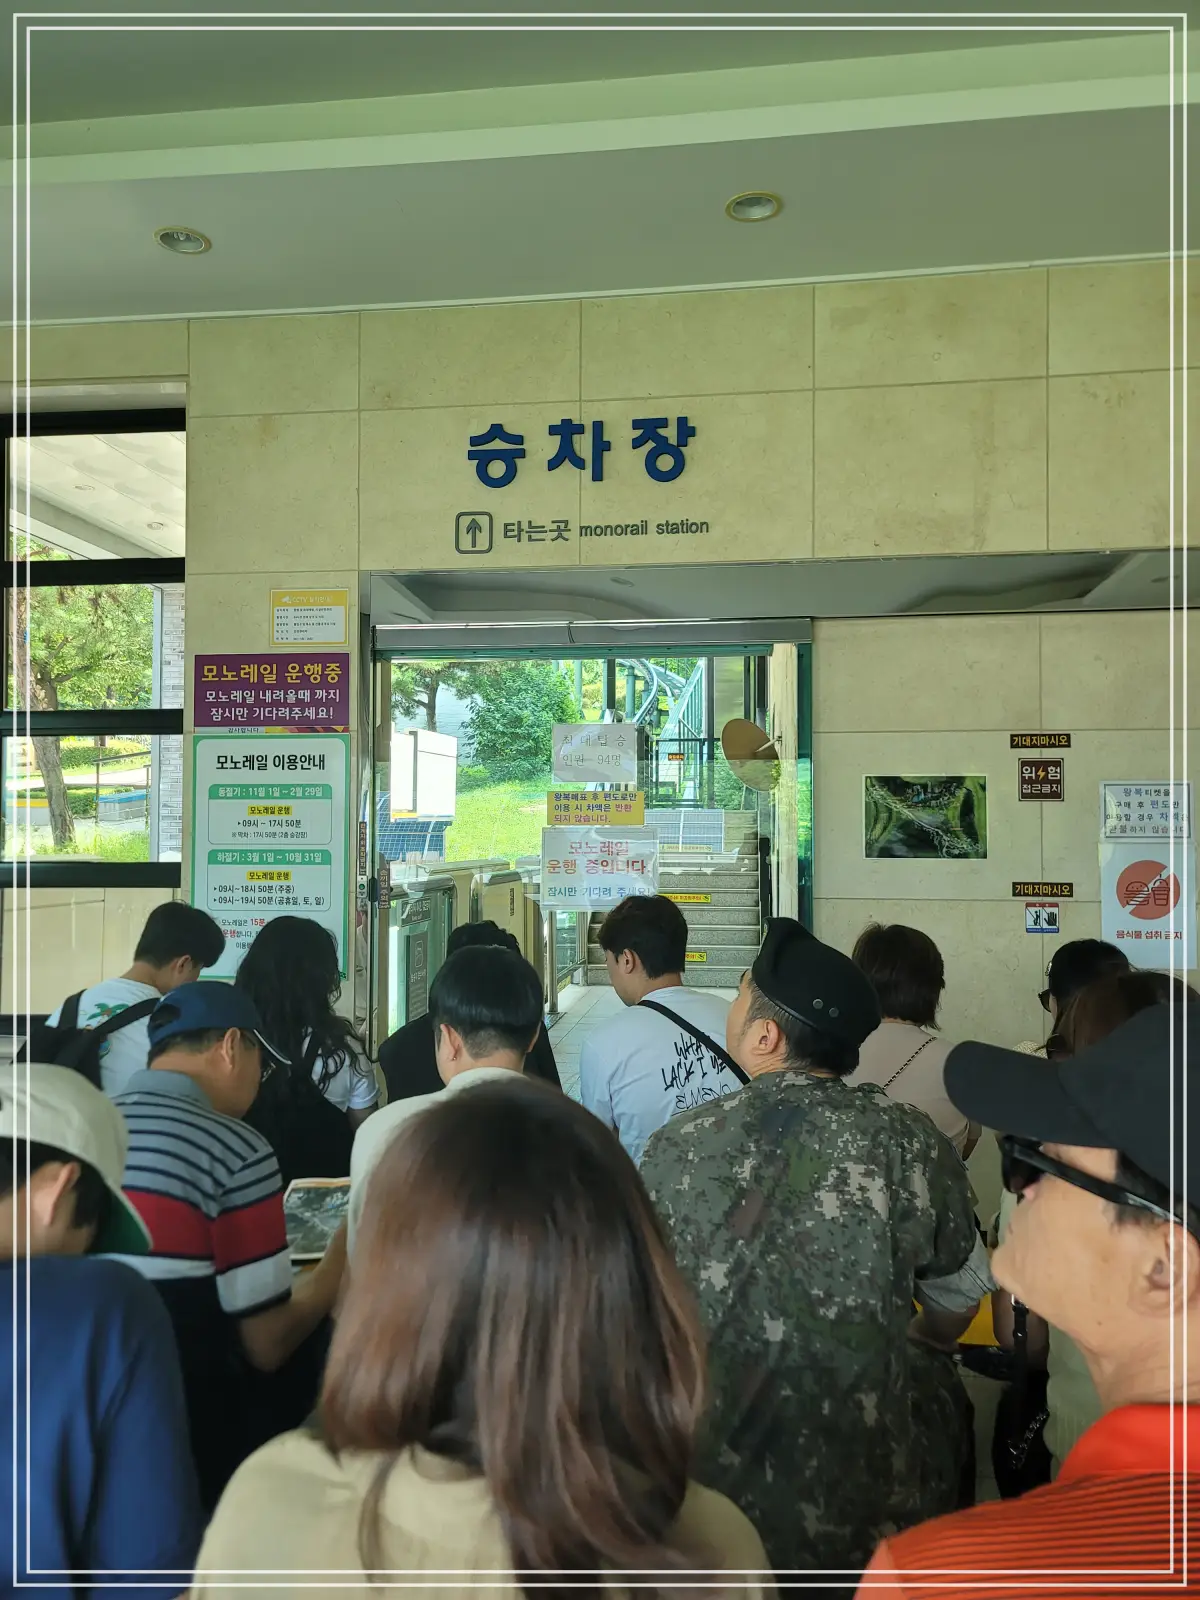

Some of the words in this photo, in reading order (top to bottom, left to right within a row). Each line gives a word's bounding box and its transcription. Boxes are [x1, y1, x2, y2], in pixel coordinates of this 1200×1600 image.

[467, 416, 697, 489] 승차장
[503, 519, 571, 543] 타는곳
[579, 520, 648, 538] monorail
[655, 519, 709, 535] station
[201, 663, 277, 684] 모노레일
[284, 662, 342, 684] 운행중
[205, 689, 255, 704] 모노레일
[259, 689, 311, 704] 내려올때
[314, 689, 340, 703] 까지
[210, 707, 248, 721] 잠시만
[252, 706, 334, 721] 기다려주세요!
[1012, 735, 1069, 747] 기대지마시오
[215, 754, 268, 771] 모노레일
[273, 754, 325, 771] 이용안내
[562, 753, 585, 767] 인원
[597, 753, 621, 767] 94명
[218, 787, 241, 797] 동절기
[248, 787, 265, 797] 11월
[268, 787, 280, 797] 1일
[290, 787, 303, 797] 2월
[305, 787, 323, 797] 29일
[1022, 784, 1061, 794] 접근금지
[591, 792, 599, 801] 후
[603, 792, 638, 802] 편도로만
[249, 806, 276, 815] 모노레일
[554, 803, 571, 812] 이용
[574, 803, 583, 812] 시
[242, 819, 259, 828] 09시
[268, 819, 283, 828] 17시
[285, 819, 302, 828] 50분
[568, 840, 629, 856] 모노레일
[217, 852, 240, 863] 하절기
[246, 852, 260, 863] 3월
[262, 852, 274, 863] 1일
[285, 852, 302, 863] 10월
[304, 852, 322, 863] 31일
[546, 859, 577, 875] 운행
[248, 872, 275, 881] 모노레일
[547, 886, 577, 897] 잠시만
[582, 886, 612, 897] 기다려
[1015, 884, 1071, 896] 기대지마시오
[673, 1032, 710, 1061] WHA
[661, 1057, 695, 1092] LACK
